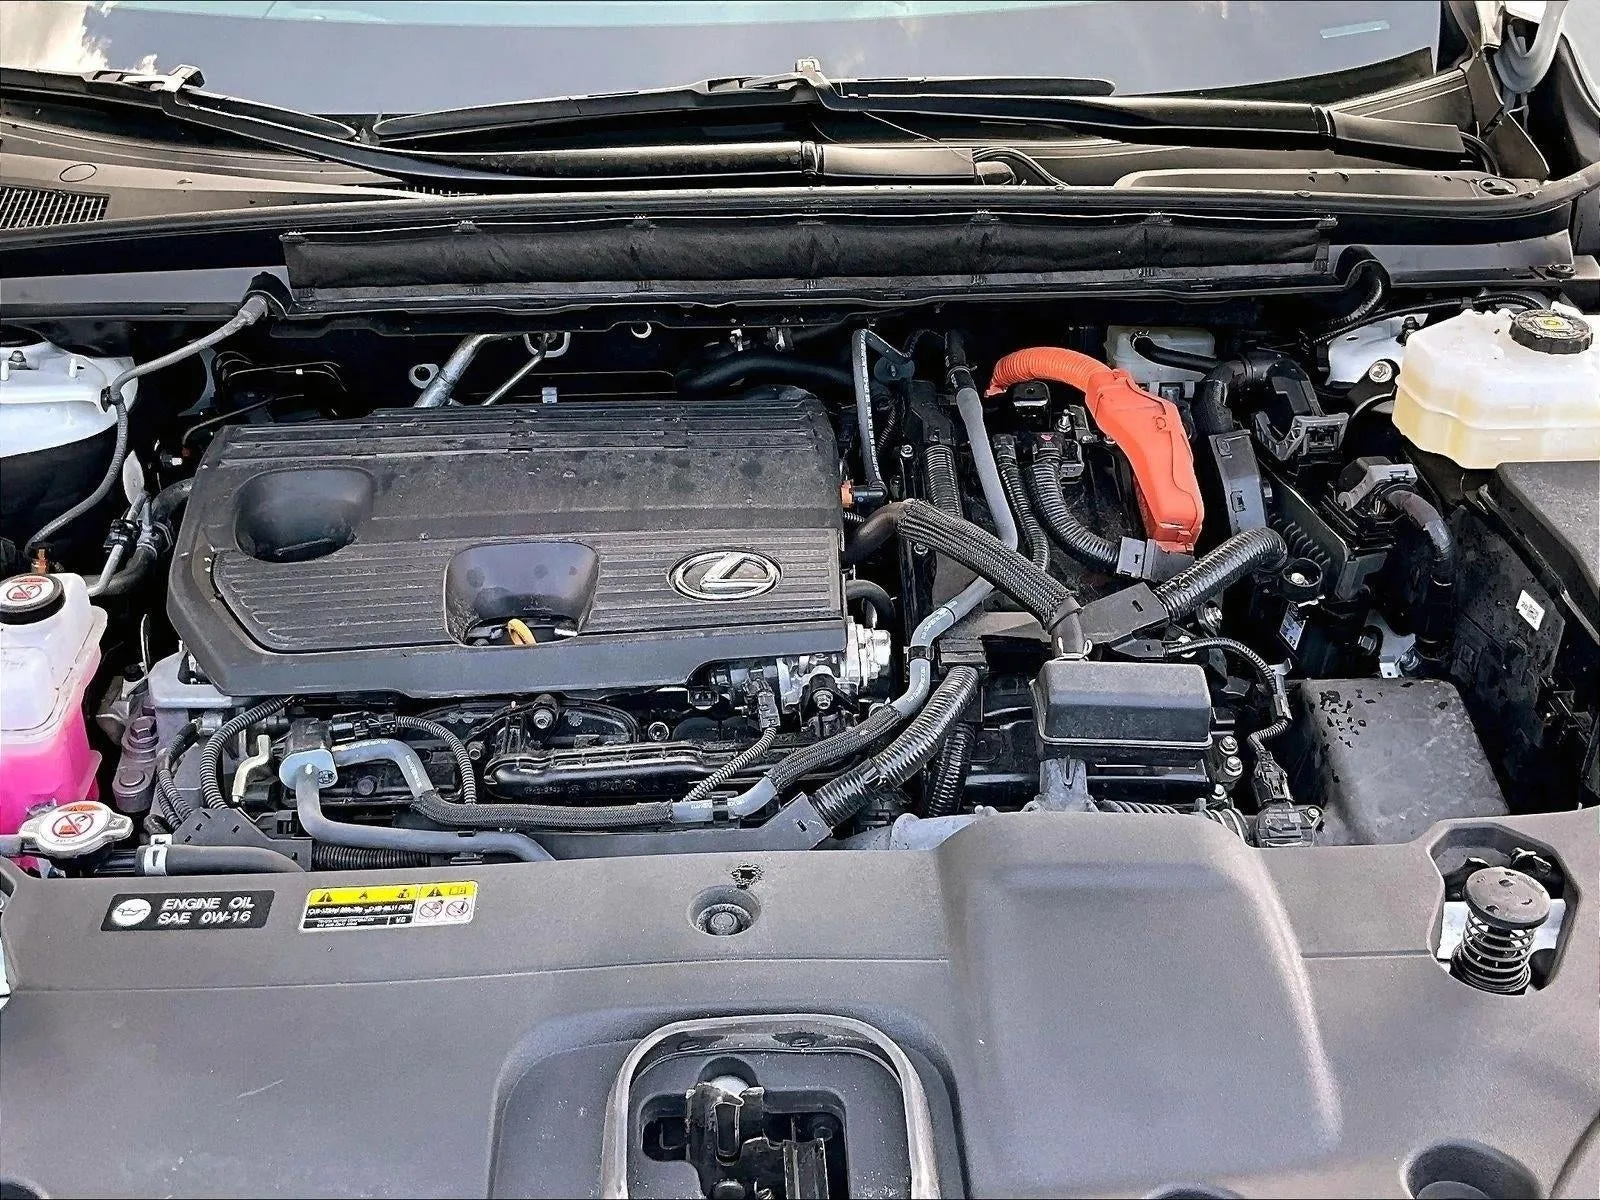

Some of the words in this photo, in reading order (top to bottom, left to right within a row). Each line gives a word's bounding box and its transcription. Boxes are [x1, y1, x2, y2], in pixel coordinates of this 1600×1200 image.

[162, 898, 222, 910] ENGINE
[229, 896, 255, 909] OIL
[158, 911, 192, 924] SAE
[201, 911, 252, 924] 0W-16
